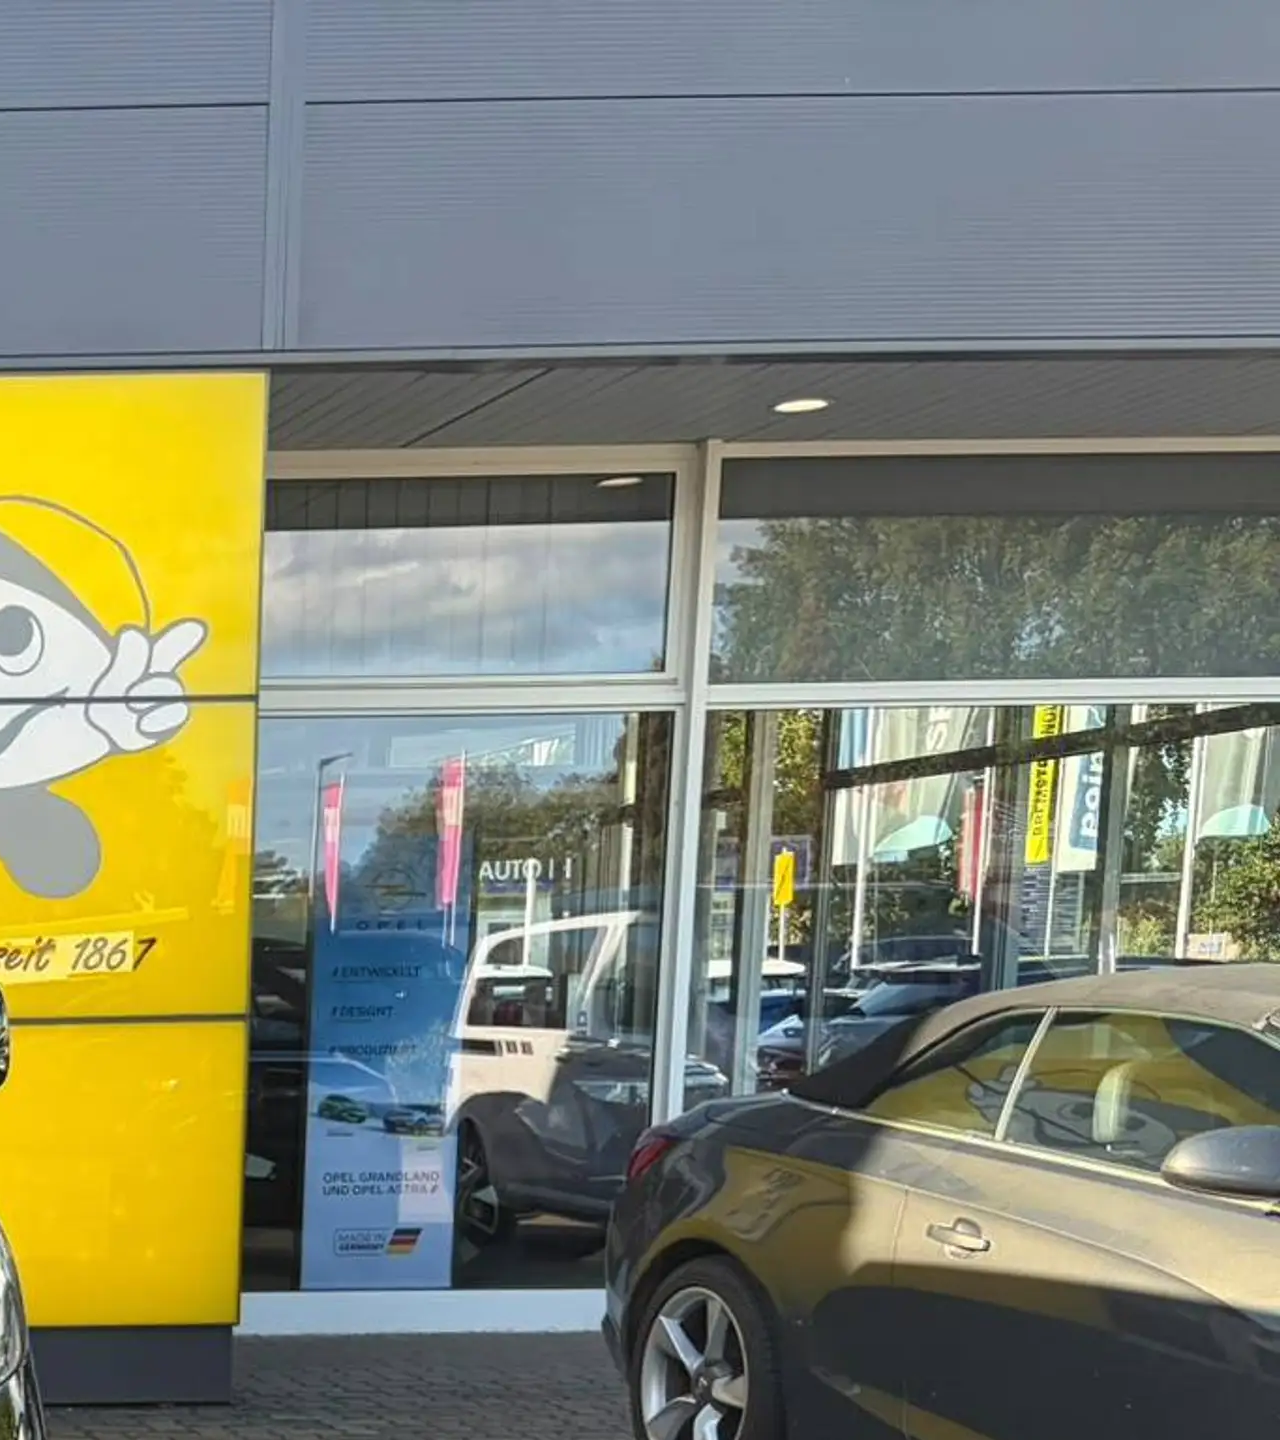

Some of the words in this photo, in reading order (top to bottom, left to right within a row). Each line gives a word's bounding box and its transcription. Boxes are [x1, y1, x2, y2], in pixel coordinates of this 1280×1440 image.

[71, 936, 157, 971] 1867
[322, 1172, 356, 1184] OPEL
[358, 1171, 440, 1183] GRANDLAND
[322, 1185, 350, 1196] UND
[352, 1185, 385, 1196] OPEL
